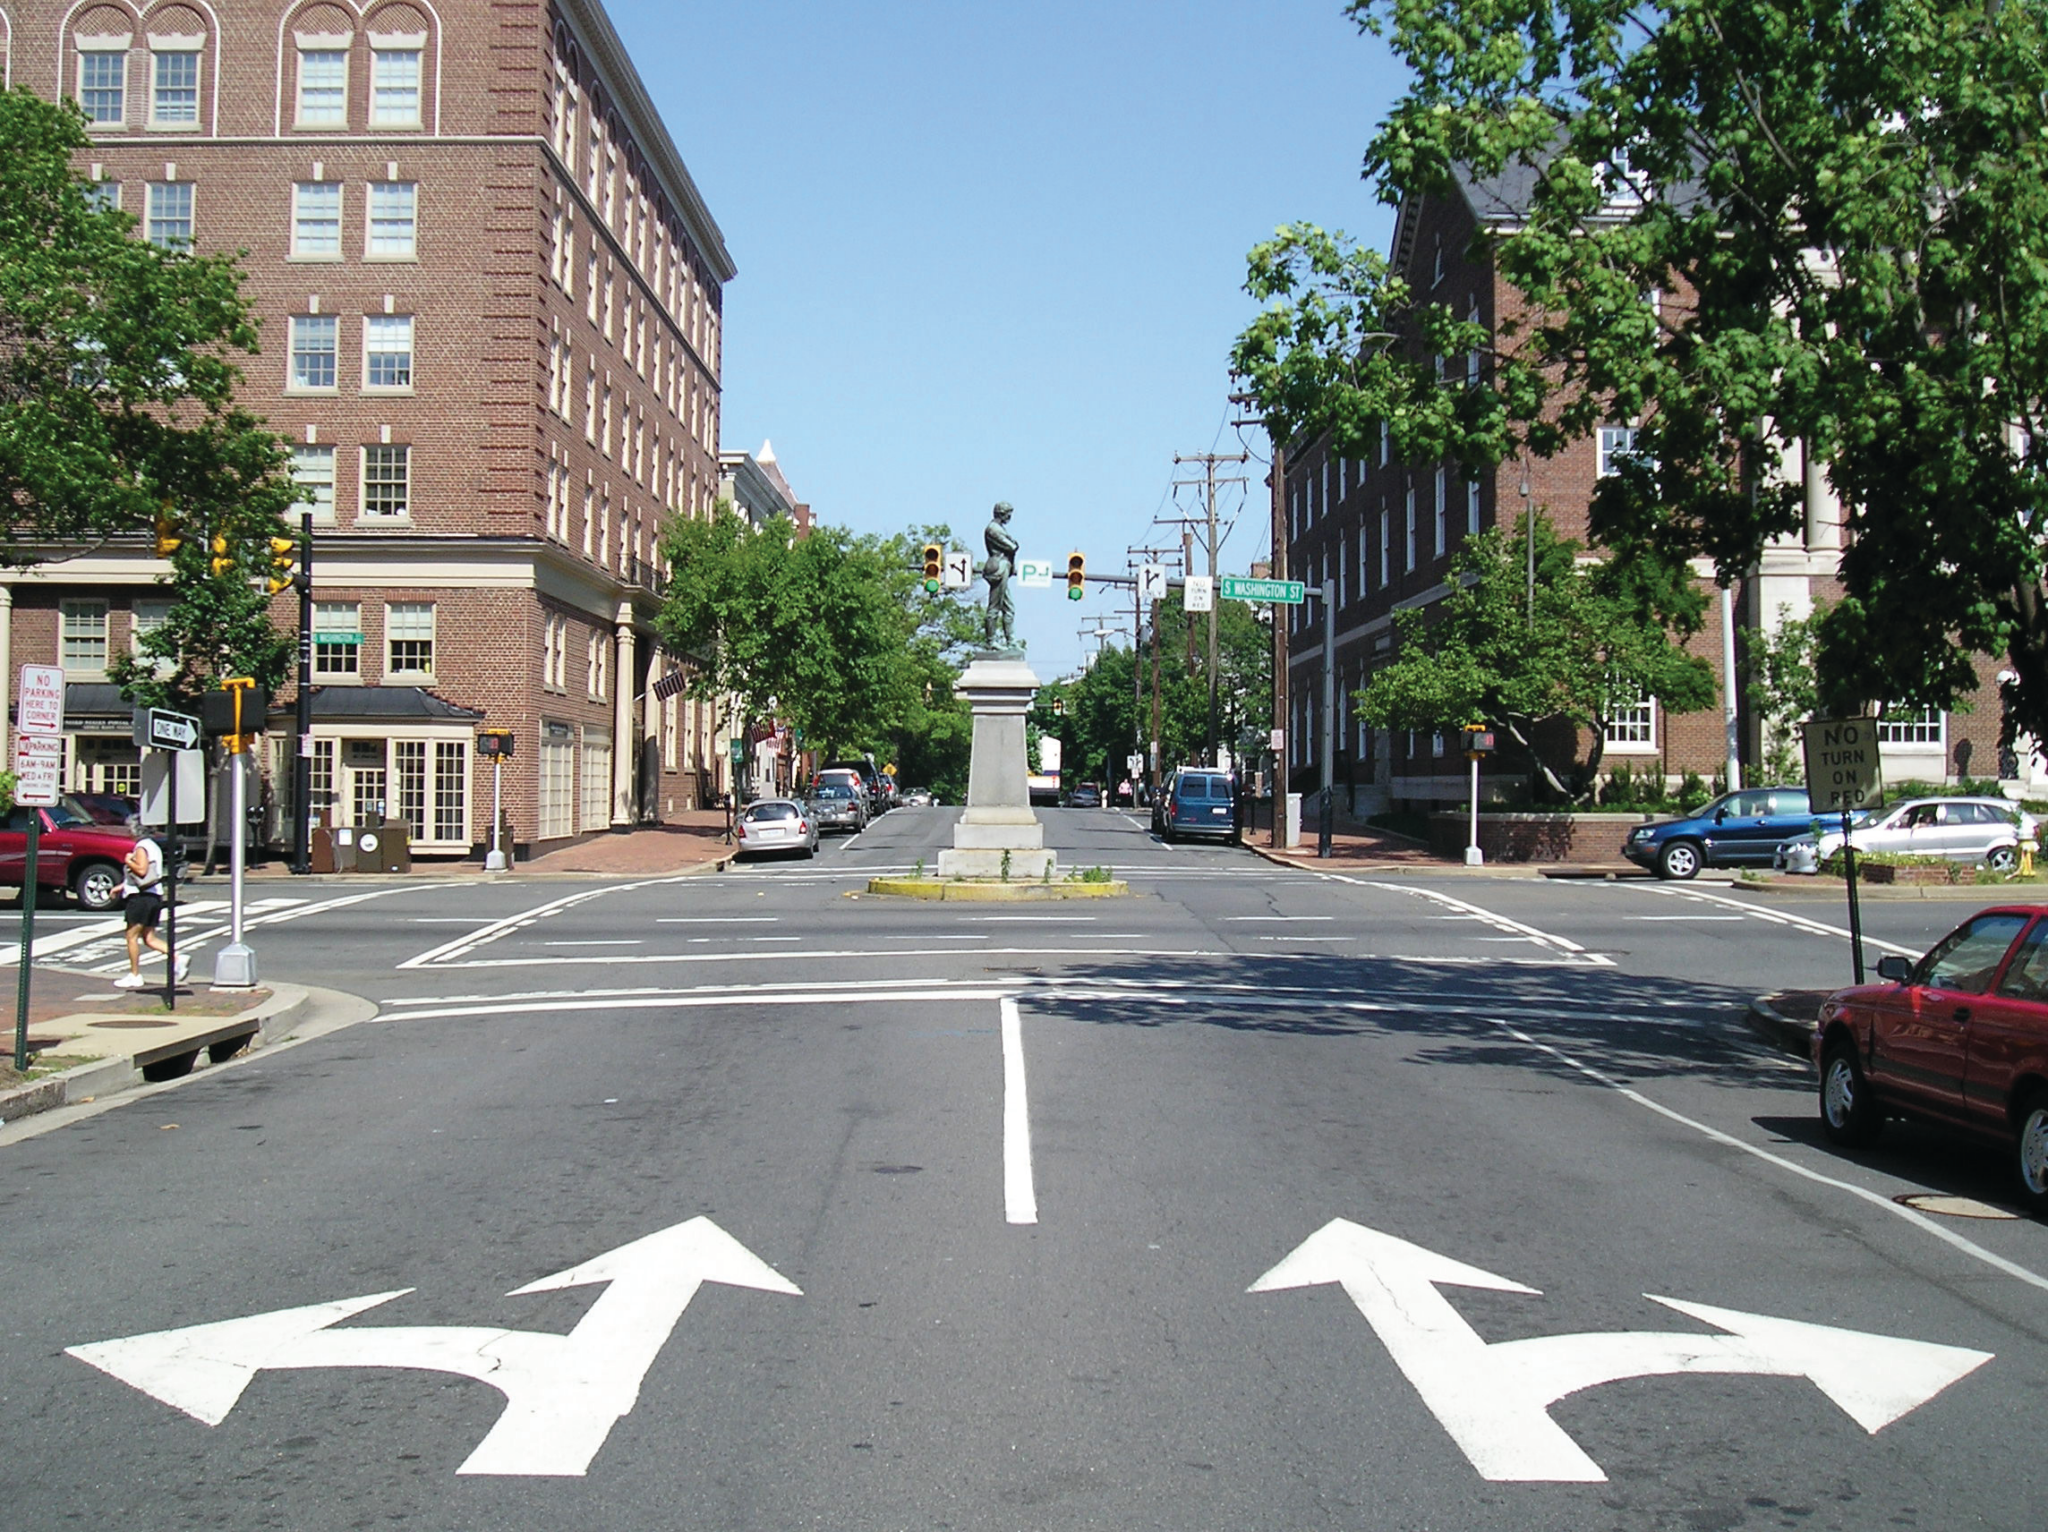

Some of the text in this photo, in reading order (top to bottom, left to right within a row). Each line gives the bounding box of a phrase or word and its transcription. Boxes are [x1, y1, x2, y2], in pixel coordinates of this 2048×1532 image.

[1192, 580, 1206, 588] NO
[1224, 580, 1301, 600] S WASHINGTON ST
[36, 674, 51, 687] NO
[24, 687, 60, 700] PARKING
[25, 699, 59, 711] HERE TO
[25, 710, 57, 721] CORNER
[156, 721, 187, 740] ONE WAY
[1824, 726, 1859, 746] NO
[29, 742, 59, 752] PARKING
[20, 760, 56, 769] 6AM-9AM
[1821, 750, 1865, 766] TURN
[20, 771, 37, 781] WED
[43, 772, 55, 781] FRI
[1832, 769, 1857, 785] ON
[1831, 789, 1865, 807] RED
